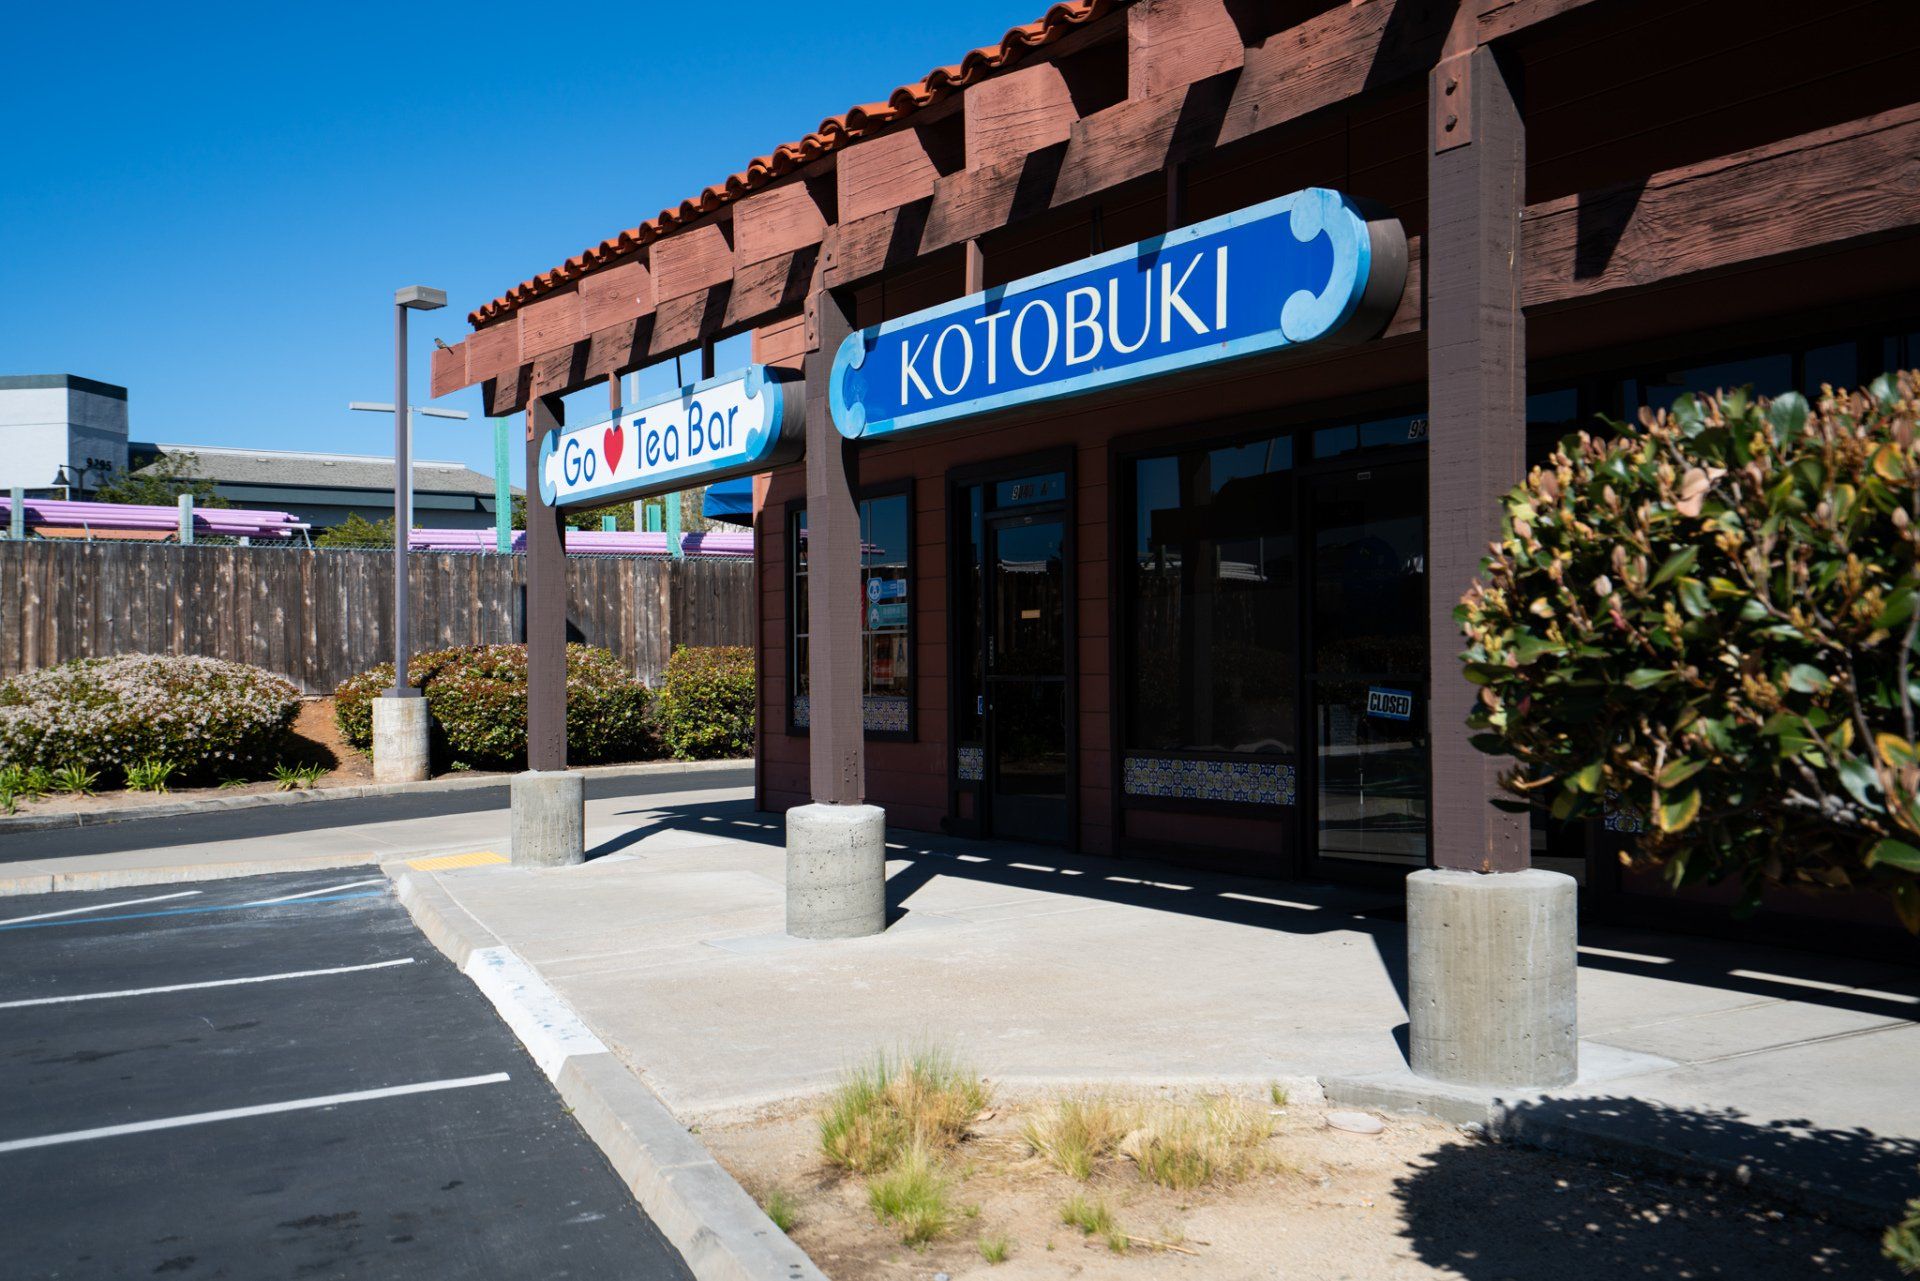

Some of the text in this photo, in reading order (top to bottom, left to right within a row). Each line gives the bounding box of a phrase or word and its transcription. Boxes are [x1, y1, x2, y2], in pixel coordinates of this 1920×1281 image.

[900, 245, 1228, 406] KOTOBUKI
[564, 400, 739, 487] Go Tea Bar
[1369, 692, 1409, 715] CLOSED
